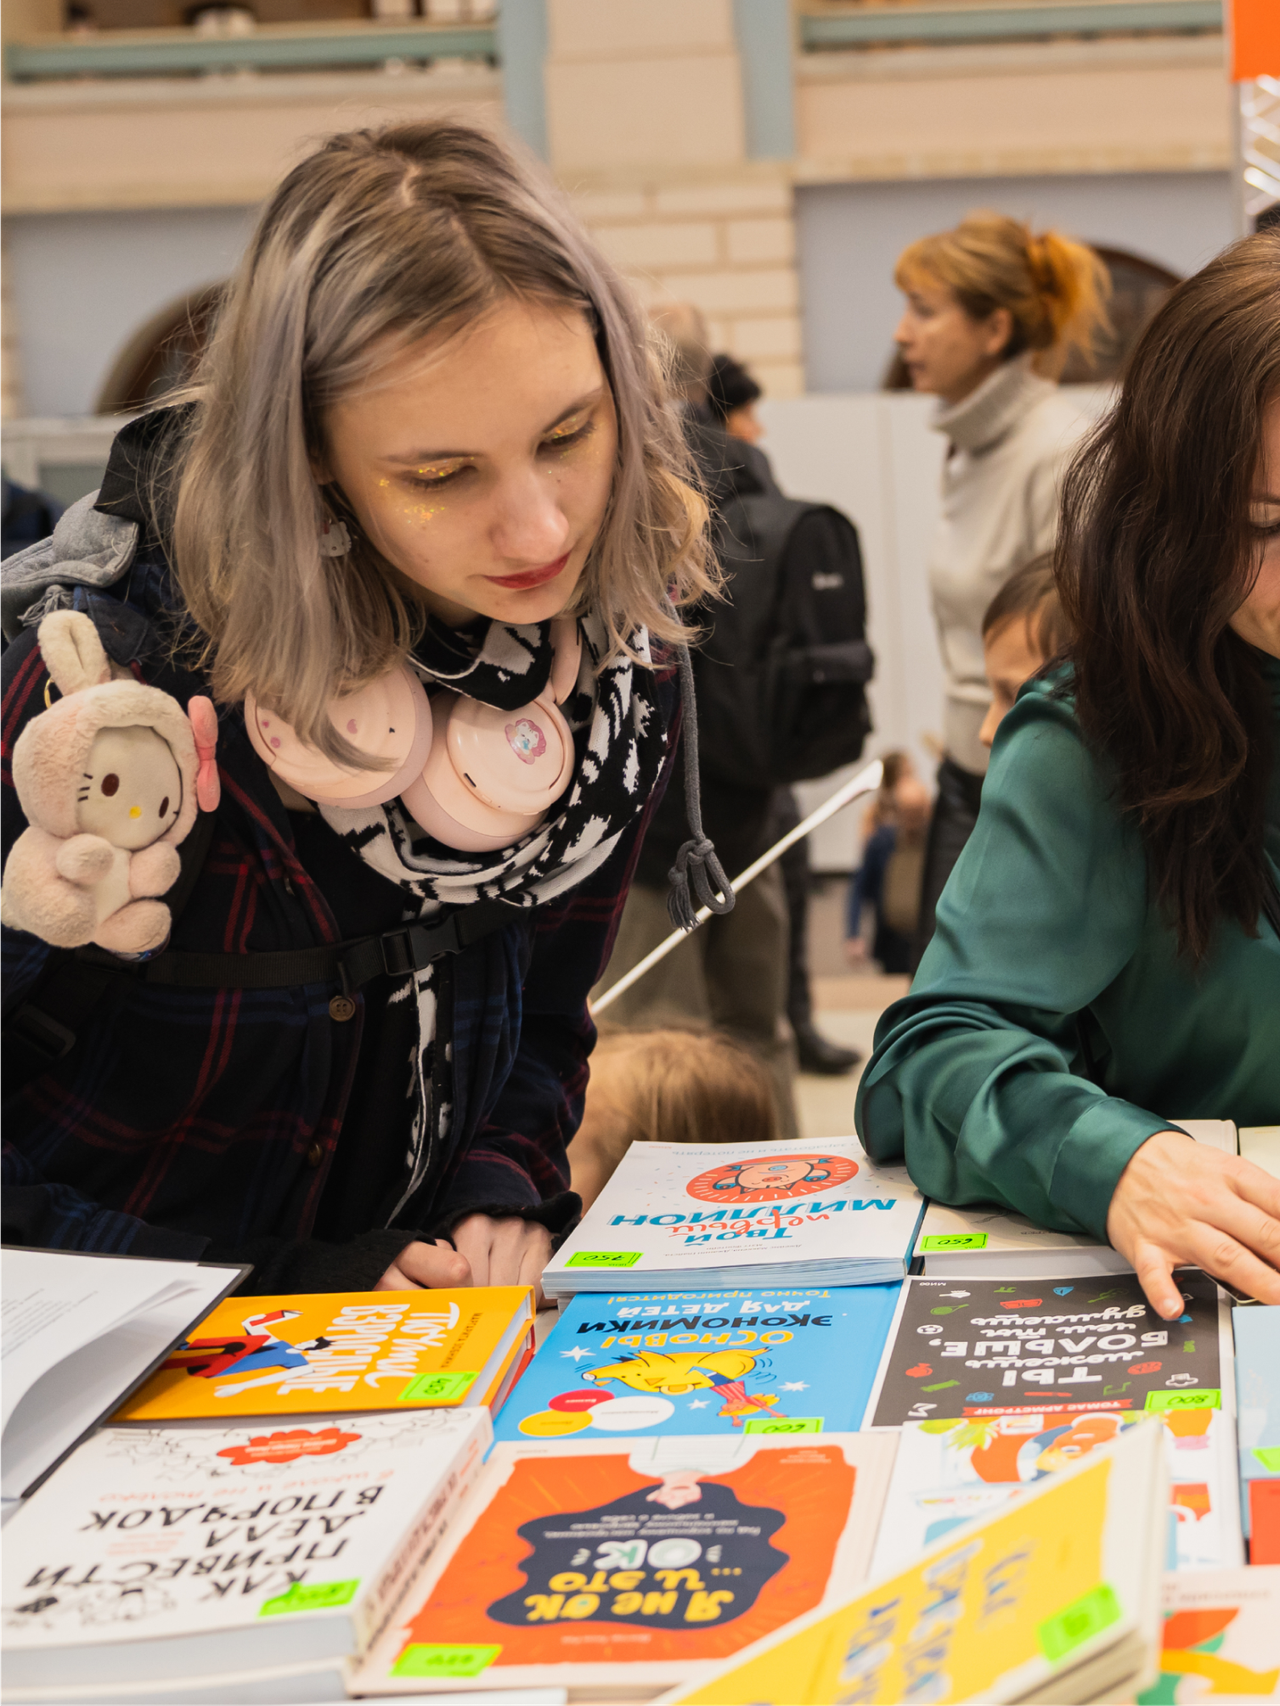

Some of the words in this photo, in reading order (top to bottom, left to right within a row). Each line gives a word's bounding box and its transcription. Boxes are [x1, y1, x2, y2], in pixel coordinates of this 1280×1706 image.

[605, 1199, 898, 1227] МИЛЛИОН
[663, 1207, 830, 1237] первый
[683, 1226, 793, 1247] Твой
[607, 1291, 752, 1305] пригодится!
[761, 1289, 832, 1298] Точно
[616, 1301, 731, 1318] ДЕТЕЙ
[741, 1299, 811, 1316] ДЛЯ
[969, 1304, 1146, 1328] думаешь
[576, 1313, 834, 1335] ЭКОНОМИКИ
[1055, 1321, 1137, 1334] чем
[600, 1329, 794, 1348] ОСНОВЫ
[928, 1330, 1169, 1358] БОЛЬШЕ,
[276, 1303, 411, 1396] ВЗРОСЛЫЕ
[964, 1350, 1144, 1369] можешь
[1002, 1366, 1102, 1387] ТЫ
[972, 1404, 1064, 1415] АРМСТРОНГ
[1066, 1400, 1121, 1412] ТОМАС
[354, 1484, 385, 1506] В
[75, 1489, 345, 1532] ПОРЯДОК
[204, 1510, 366, 1549] ДЕЛА
[23, 1538, 349, 1589] ПРИВЕСТИ
[683, 1590, 735, 1622] Я
